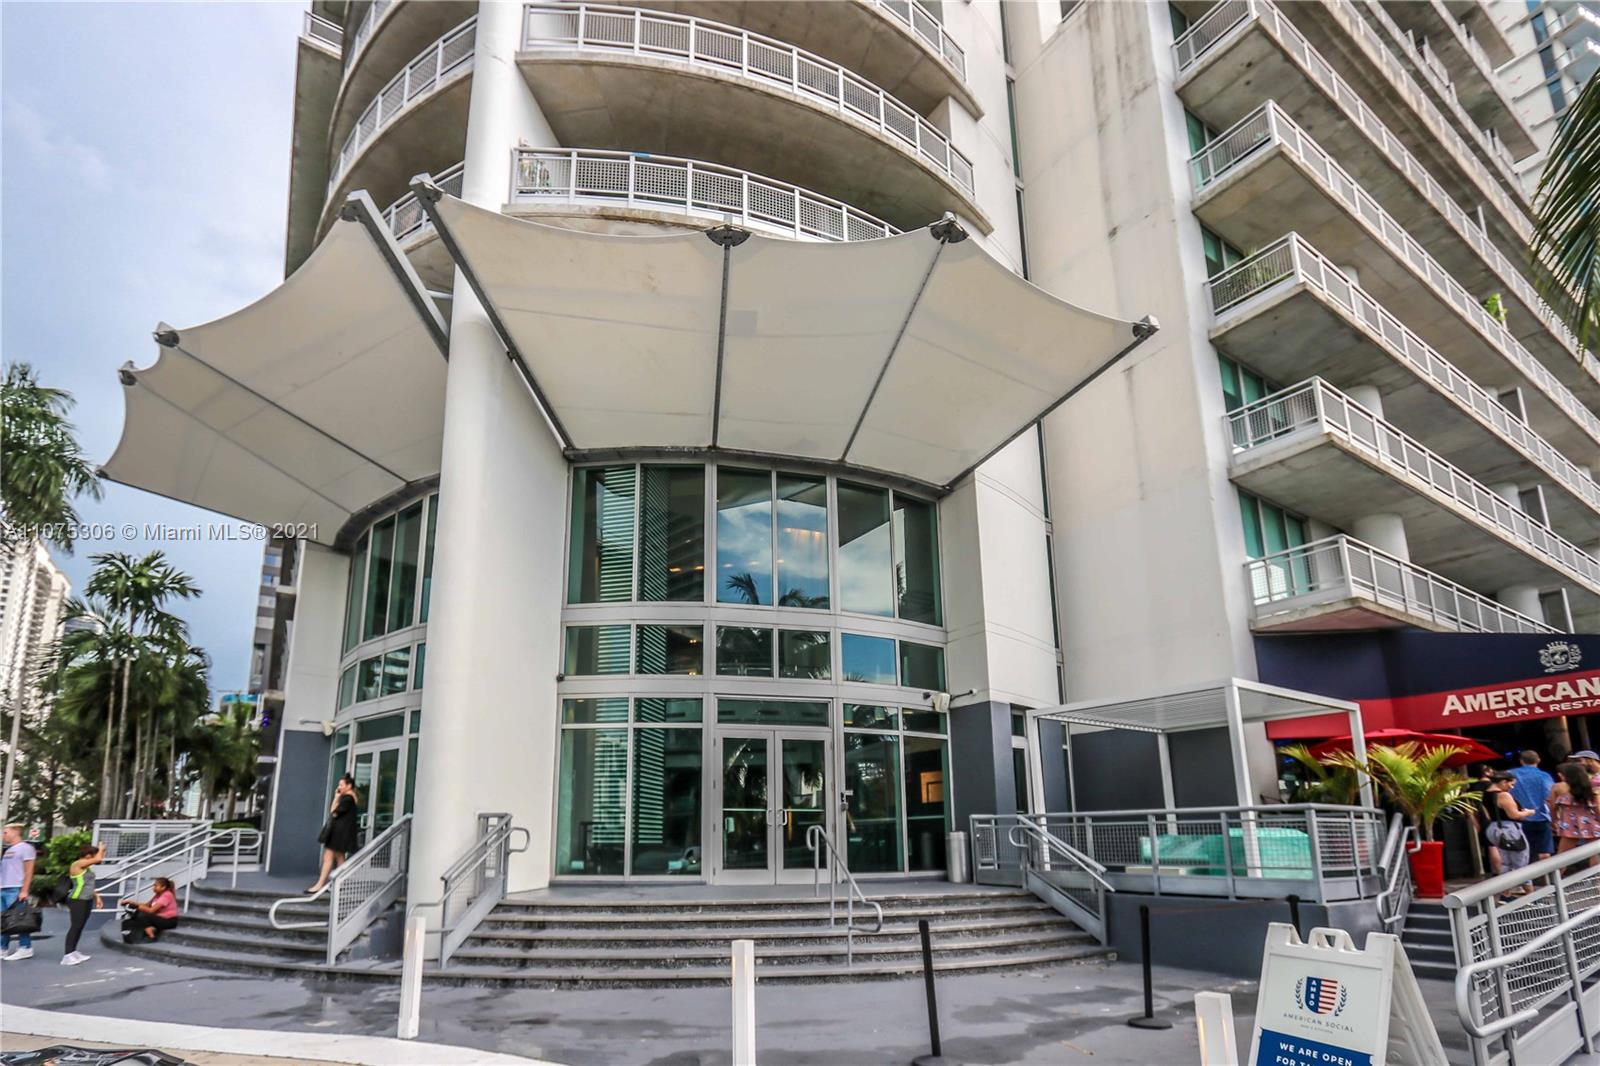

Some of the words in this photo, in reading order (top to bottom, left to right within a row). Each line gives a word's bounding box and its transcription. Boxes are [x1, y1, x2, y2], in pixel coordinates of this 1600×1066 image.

[1441, 677, 1600, 716] AMERICAN
[1495, 707, 1529, 719] BAR
[1534, 706, 1544, 714] &
[1283, 1012, 1322, 1025] AMERICAN
[1325, 1021, 1354, 1033] SOCIAL
[1276, 1055, 1296, 1066] FOR
[1279, 1042, 1295, 1053] WE
[1298, 1047, 1318, 1059] ARE
[1322, 1053, 1352, 1066] OPEN
